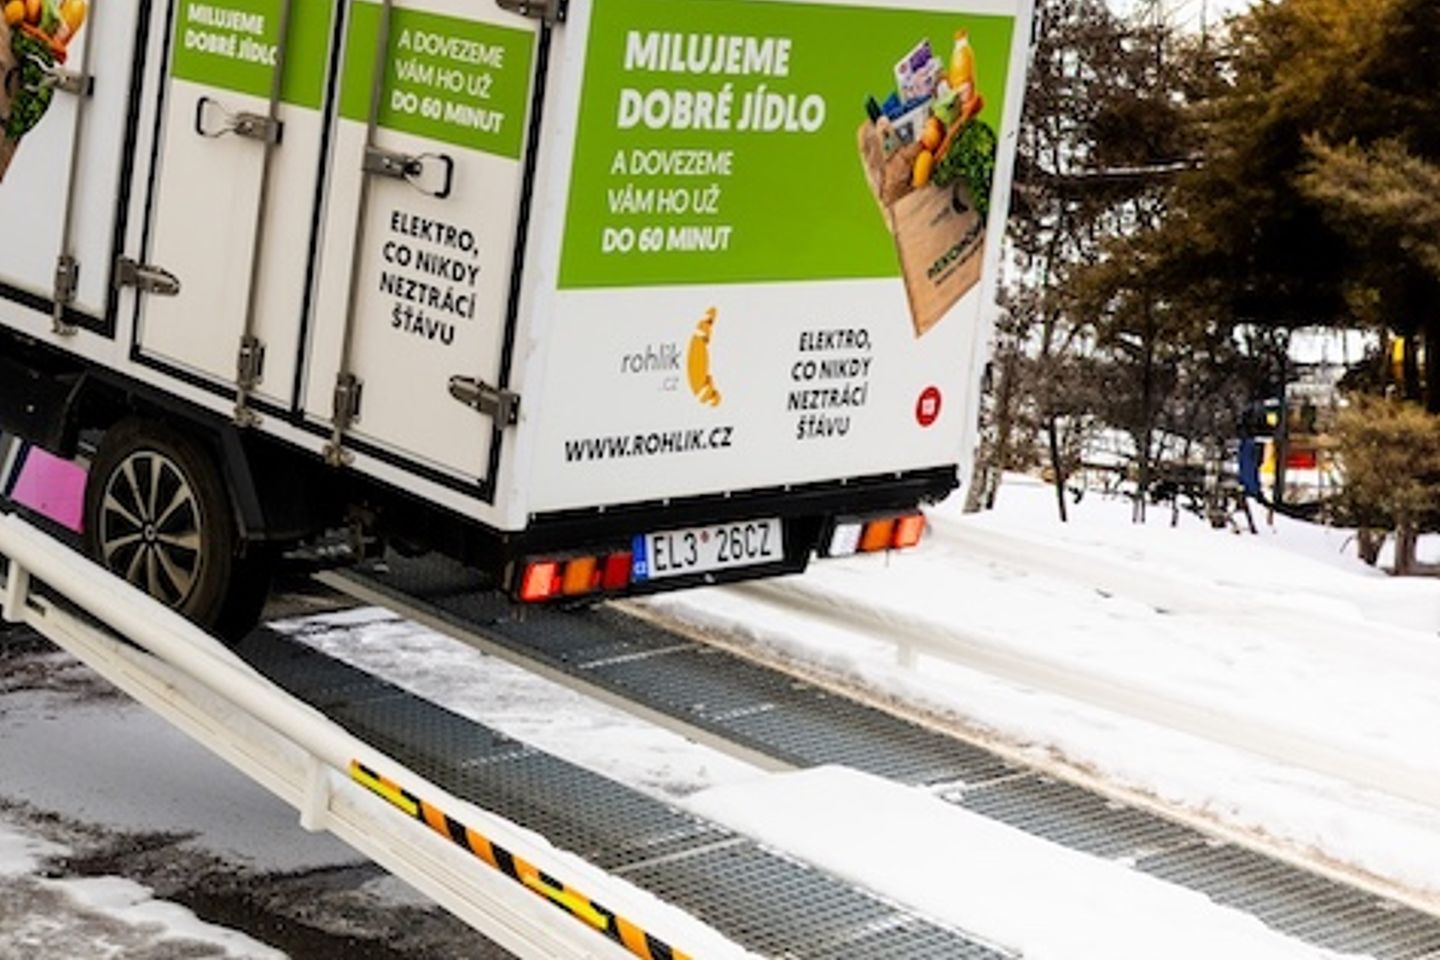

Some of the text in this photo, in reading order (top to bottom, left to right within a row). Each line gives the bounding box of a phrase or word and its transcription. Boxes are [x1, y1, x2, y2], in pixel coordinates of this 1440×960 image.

[187, 3, 265, 35] MILUJEME
[184, 29, 237, 58] DOBRÉ
[398, 29, 504, 69] A DOVEZEME
[624, 30, 792, 77] MILUJEME
[395, 58, 492, 99] VÁM HO UŽ
[391, 90, 505, 134] DO 60 MINUT
[617, 83, 826, 133] DOBRÉ JÍDLO
[611, 150, 734, 176] A DOVEZEME
[607, 184, 721, 214] VÁM HO UŽ
[391, 210, 478, 258] ELEKTRO,
[601, 226, 732, 254] DO 60 MINUT
[382, 241, 479, 287] CO NIKDY
[379, 271, 476, 319] NEZTRÁCÍ
[621, 342, 681, 373] rohlik
[799, 328, 872, 352] ELEKTRO,
[791, 357, 872, 381] CO NIKDY
[787, 381, 868, 410] NEZTRÁCÍ
[564, 426, 733, 462] WWW.ROHLIK.CZ
[653, 532, 698, 572] EL3
[715, 521, 772, 563] 26CZ
